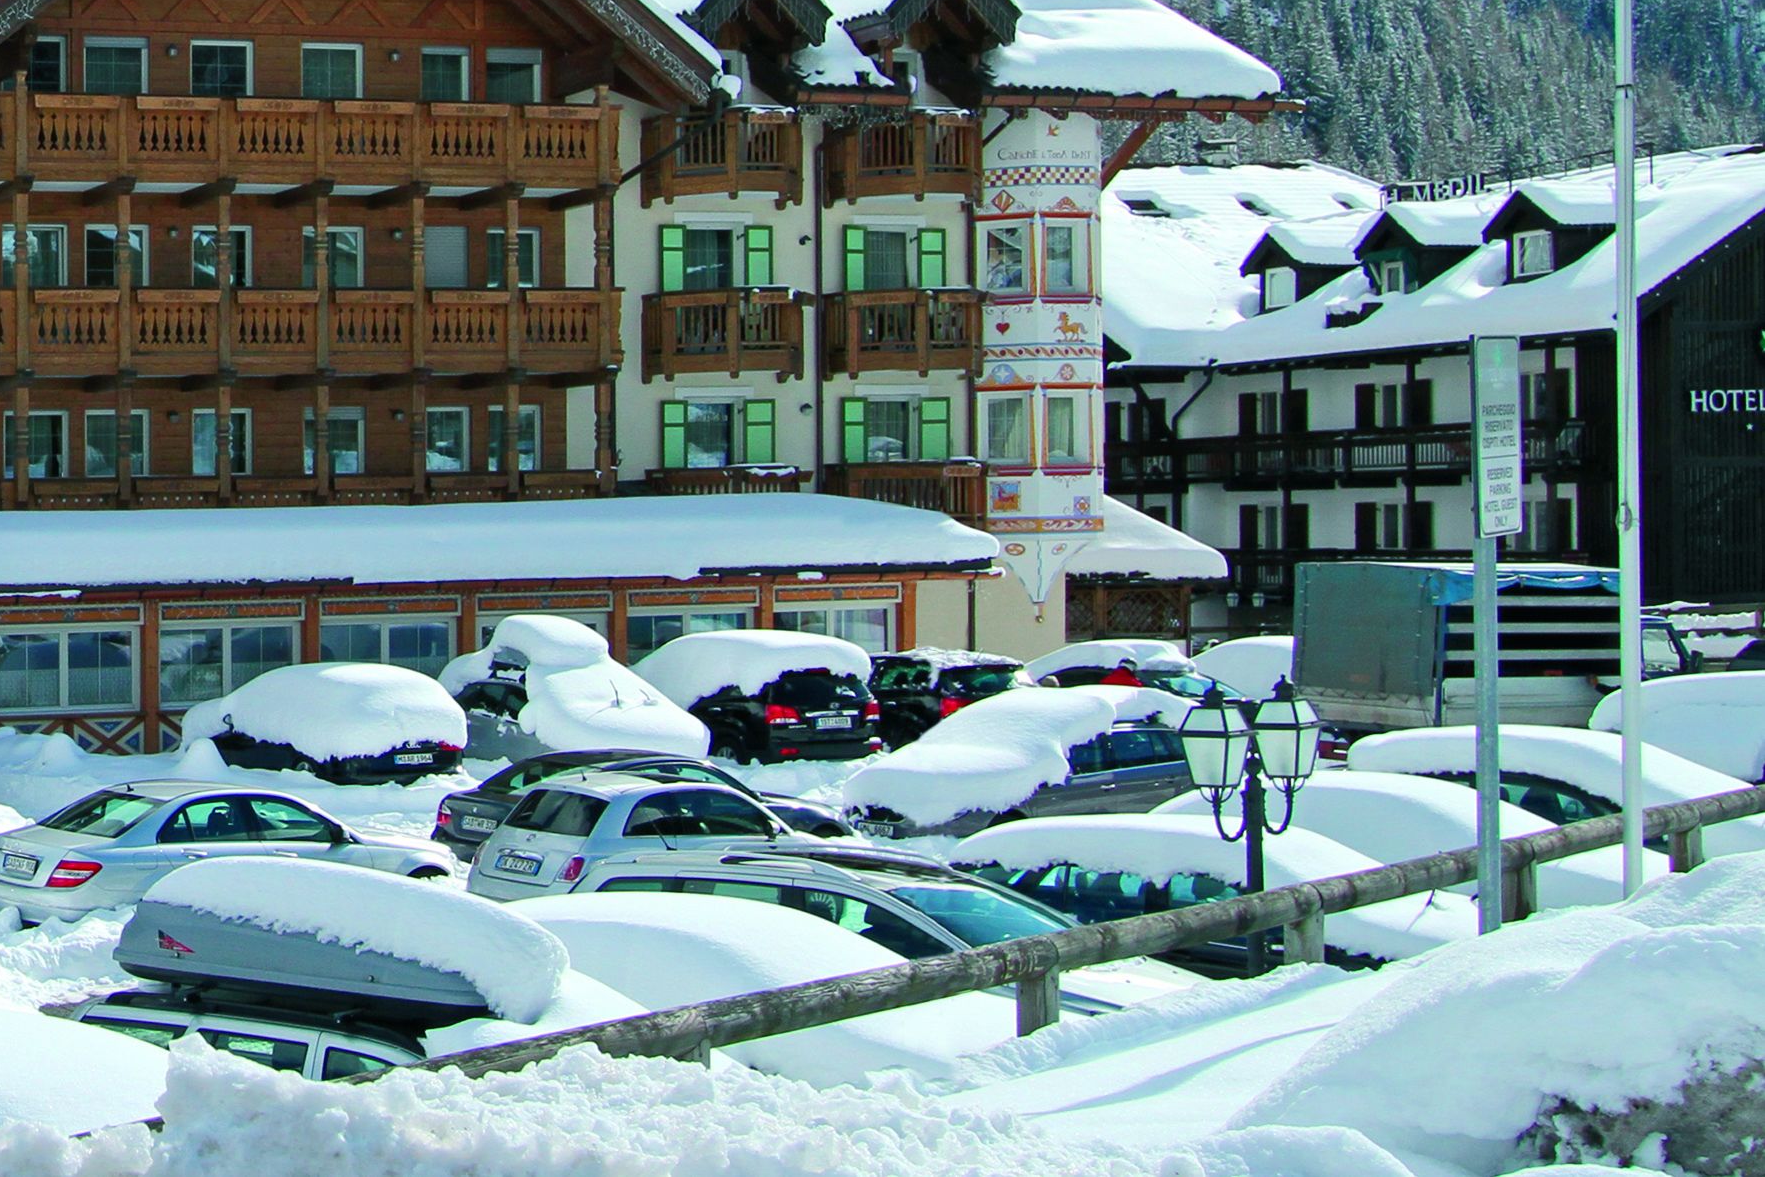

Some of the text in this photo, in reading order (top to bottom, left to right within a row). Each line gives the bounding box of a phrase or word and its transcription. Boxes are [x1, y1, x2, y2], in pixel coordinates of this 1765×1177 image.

[1412, 173, 1492, 203] MEDIL
[1690, 389, 1765, 413] HOTEL
[1484, 419, 1514, 433] RISERVATO
[1499, 435, 1516, 447] HOTEL
[1486, 466, 1513, 481] RESERVED
[1488, 483, 1512, 496] PARKING
[1483, 500, 1501, 513] HOTEL
[1494, 515, 1508, 528] ONLY
